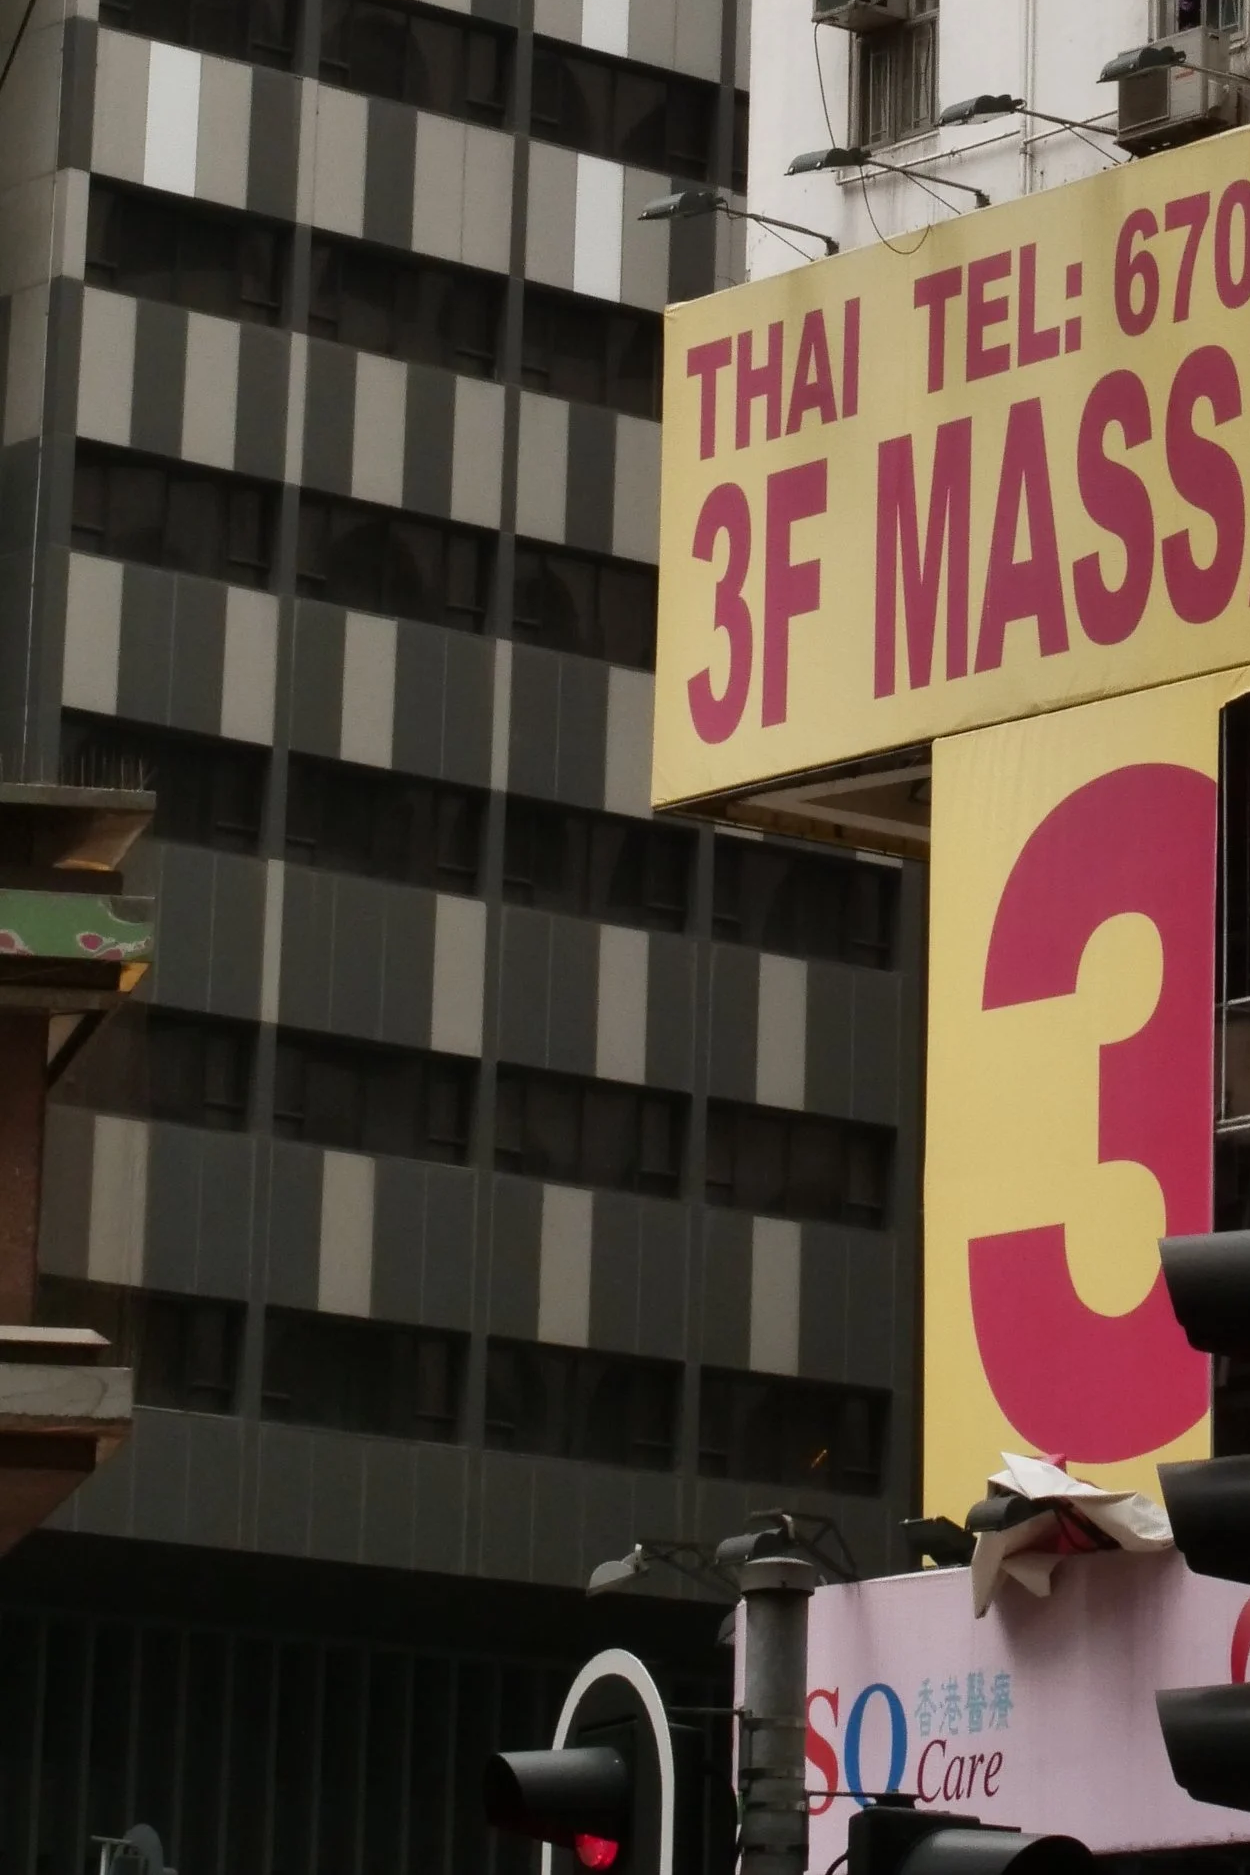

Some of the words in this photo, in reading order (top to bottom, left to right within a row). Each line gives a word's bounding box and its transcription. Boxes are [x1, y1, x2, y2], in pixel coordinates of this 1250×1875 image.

[688, 301, 860, 459] THAI
[915, 246, 1082, 391] TEL:
[687, 461, 829, 745] 3F
[967, 762, 1216, 1467] 3
[916, 1738, 1004, 1803] Care
